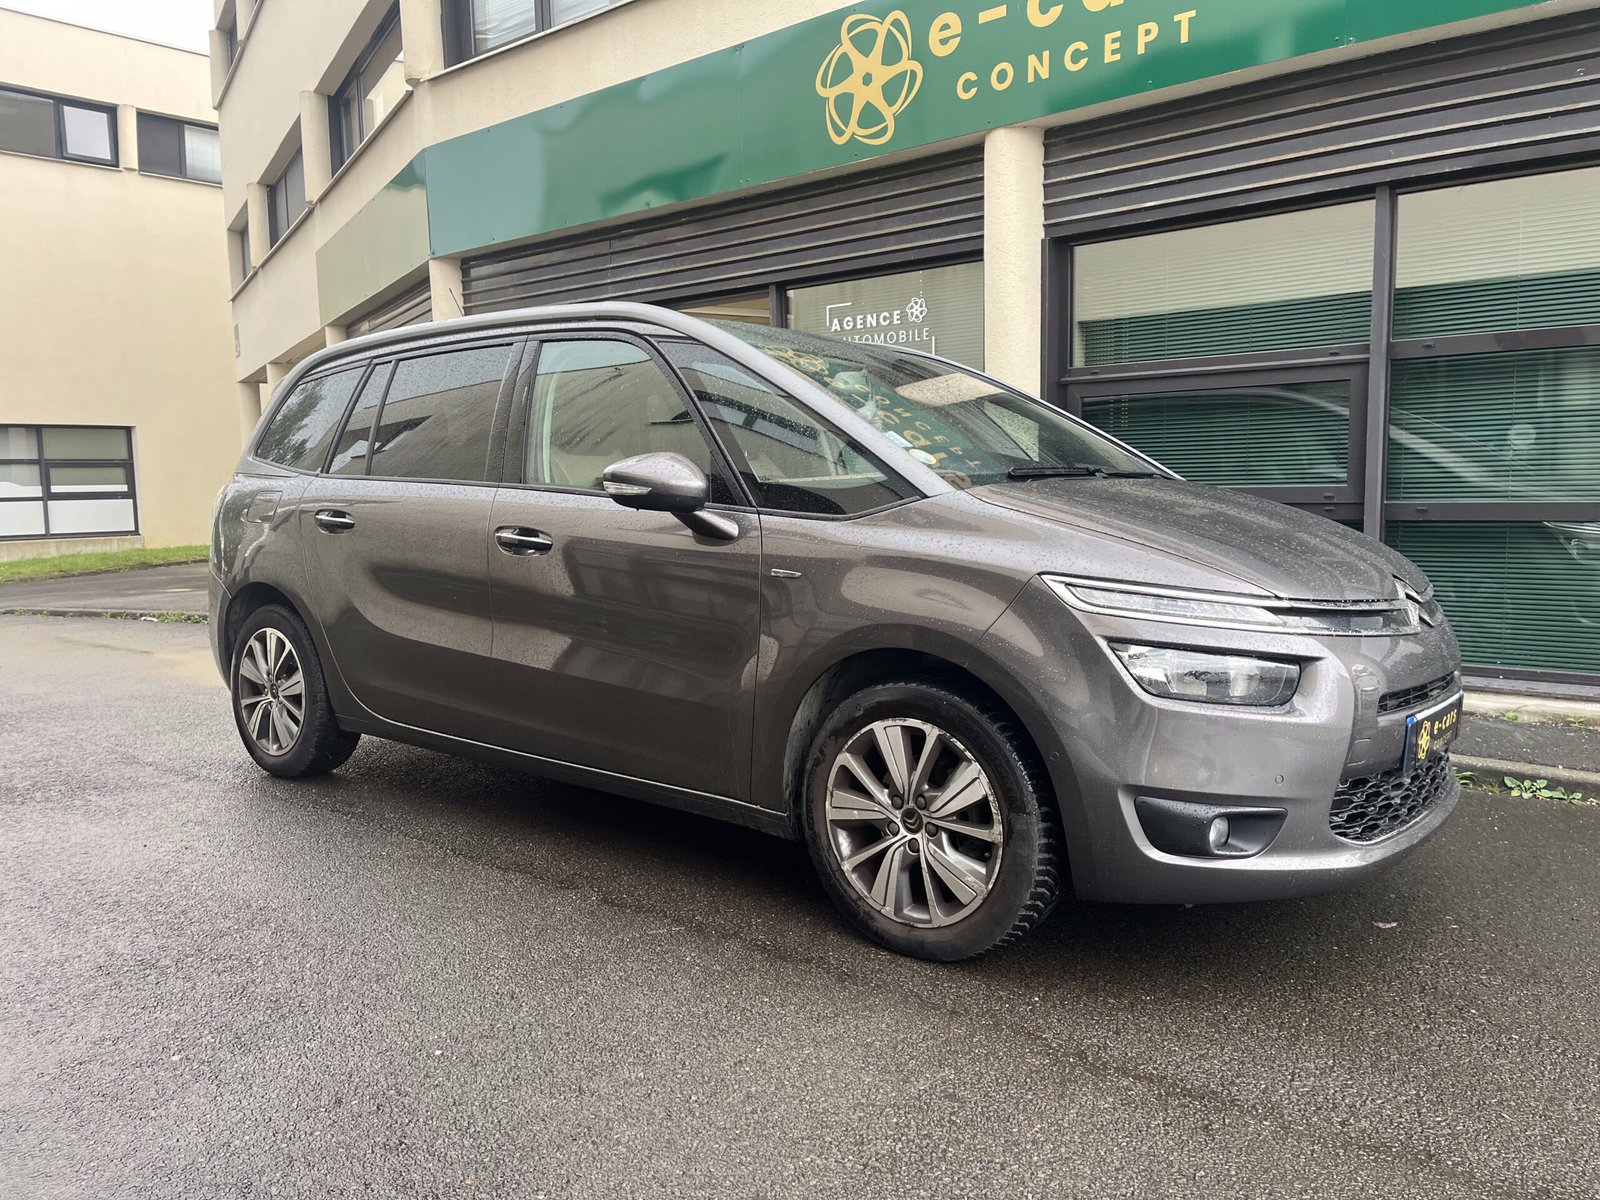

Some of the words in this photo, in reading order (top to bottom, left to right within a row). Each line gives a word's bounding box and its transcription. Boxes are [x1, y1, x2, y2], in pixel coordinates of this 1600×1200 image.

[929, 0, 1124, 57] e-c
[956, 10, 1197, 100] CONCEPT
[831, 310, 901, 332] AGENCE
[843, 327, 930, 344] TOMOBILE
[1434, 709, 1457, 735] e-cars
